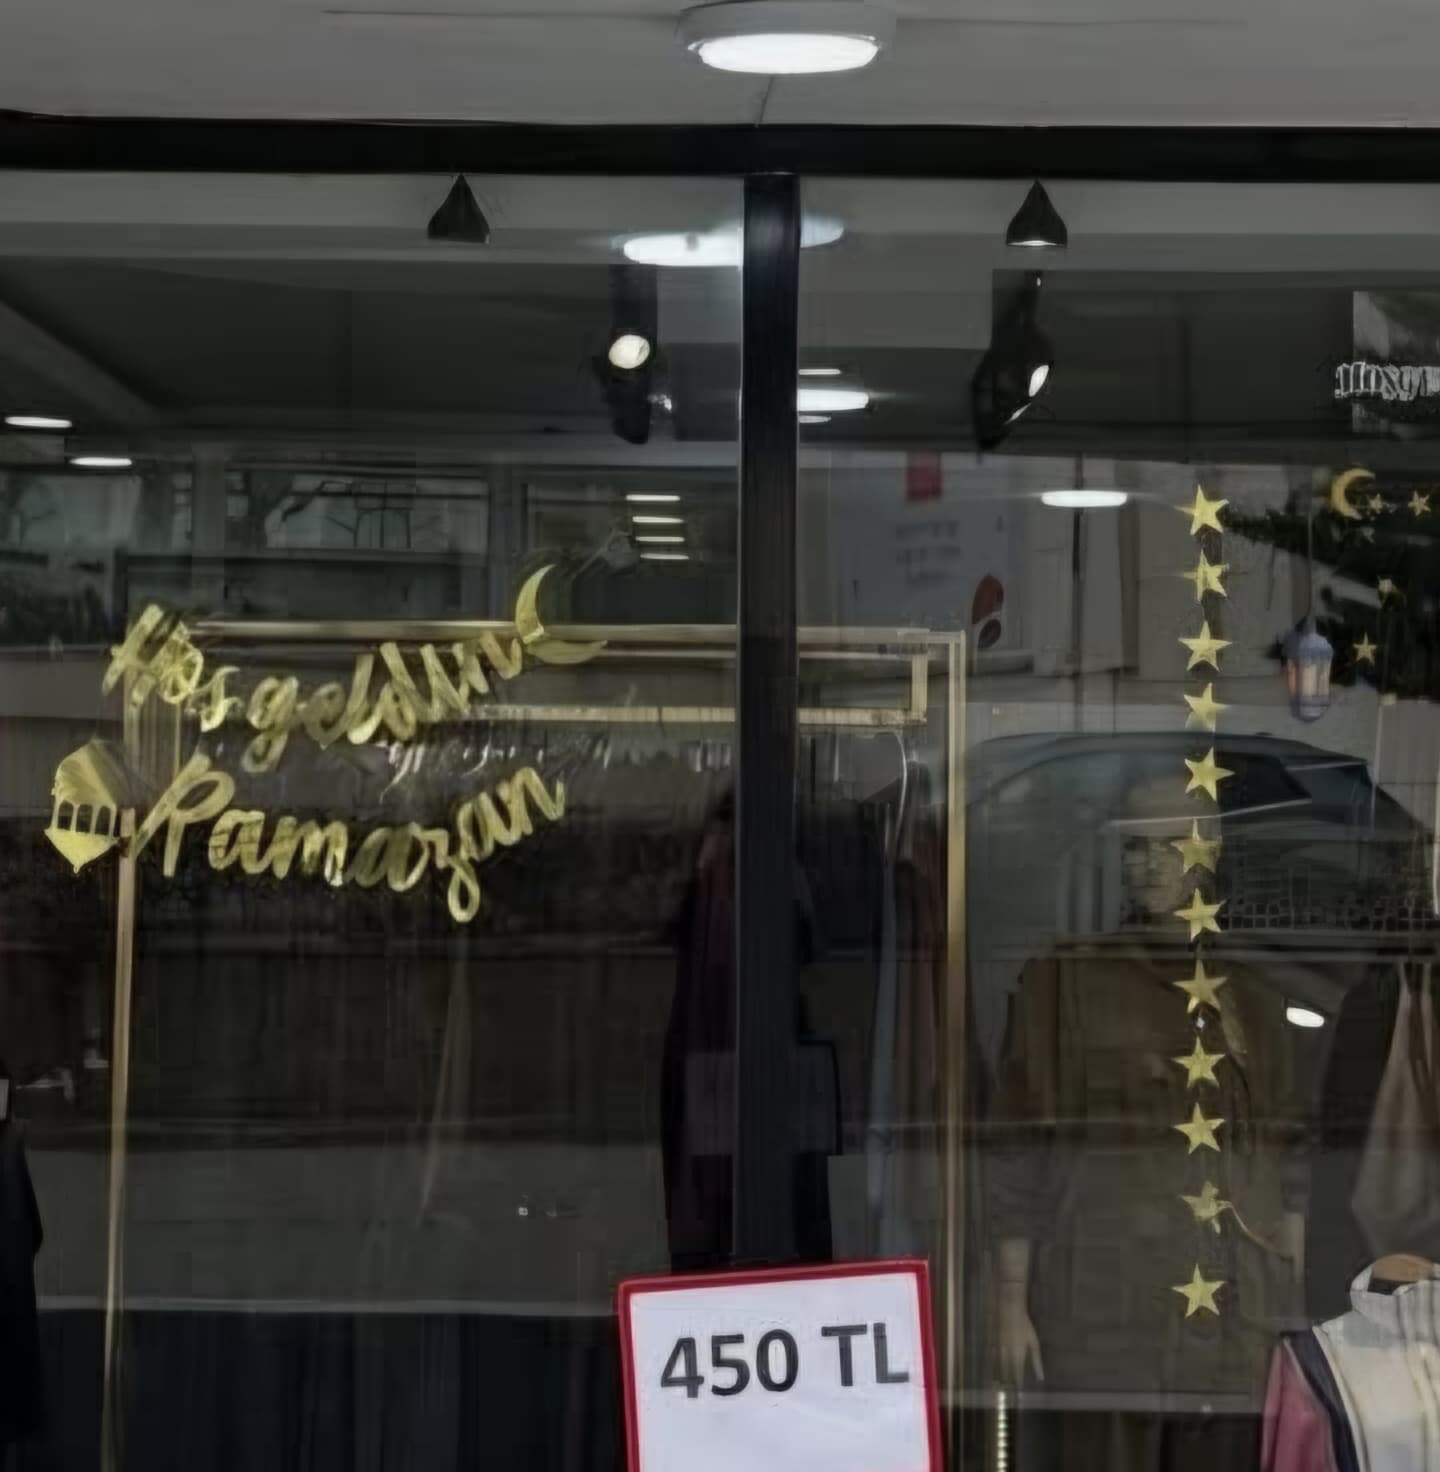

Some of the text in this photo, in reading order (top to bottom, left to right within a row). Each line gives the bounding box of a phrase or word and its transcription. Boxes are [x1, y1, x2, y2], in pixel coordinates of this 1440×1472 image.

[133, 752, 564, 923] Ramazan
[660, 1322, 910, 1399] 450 TL
